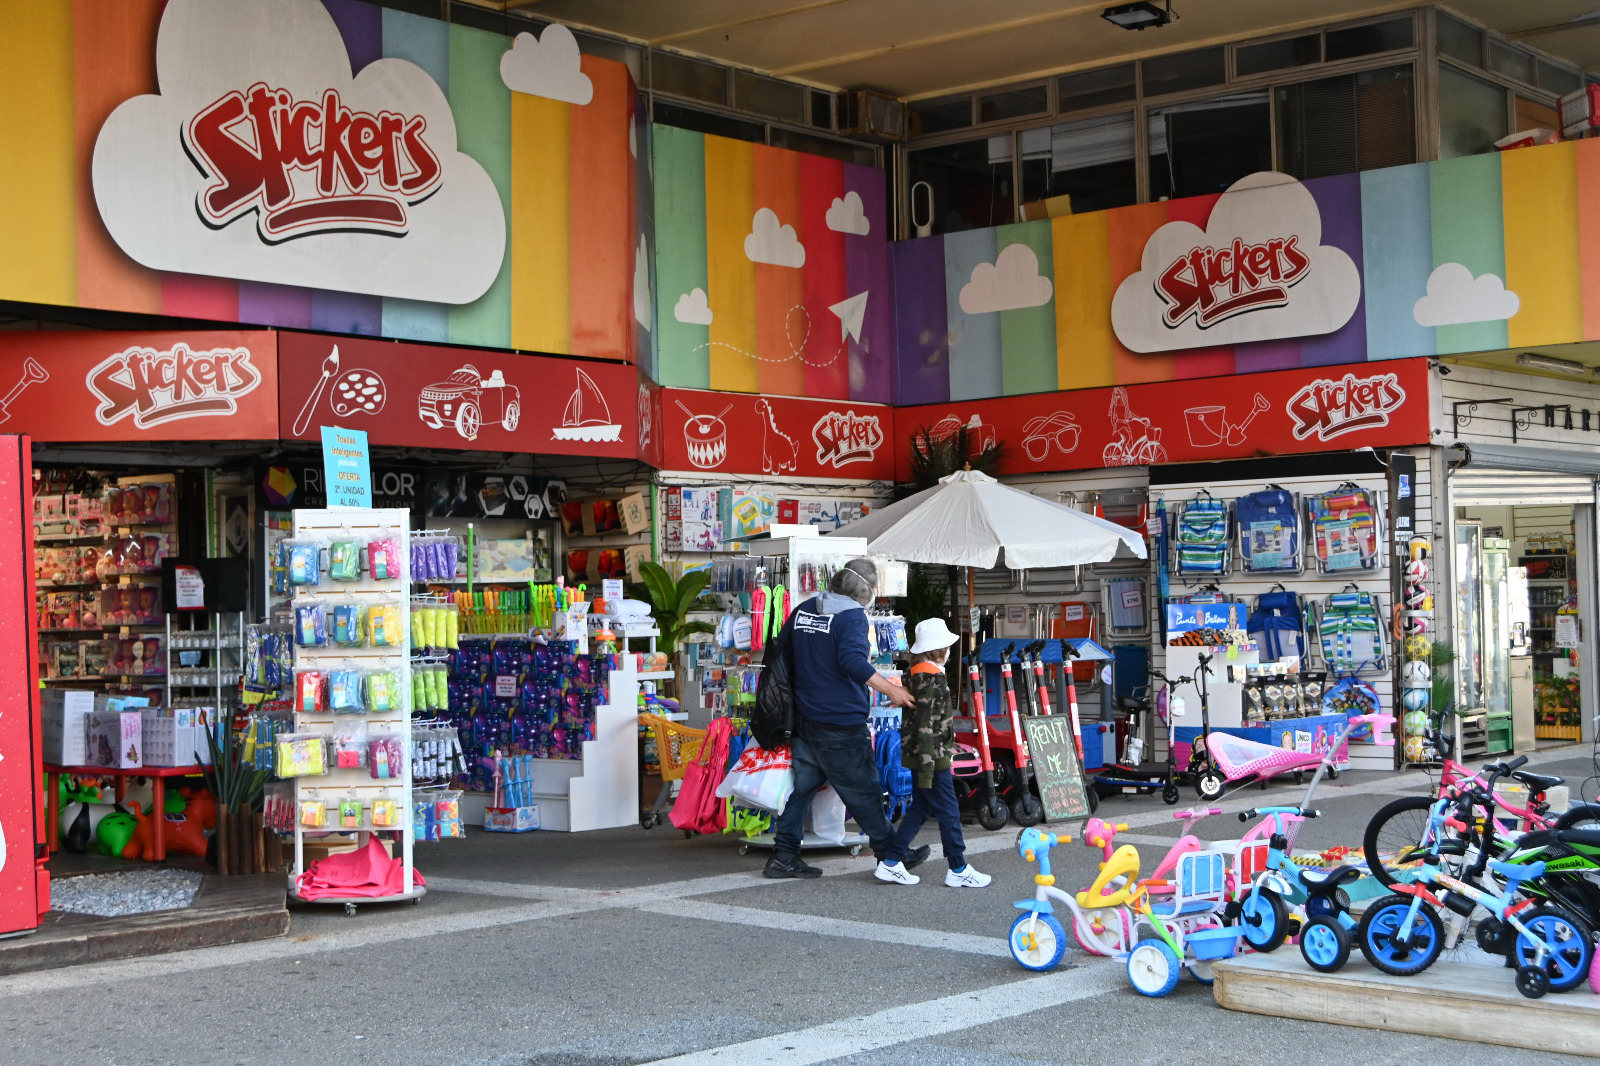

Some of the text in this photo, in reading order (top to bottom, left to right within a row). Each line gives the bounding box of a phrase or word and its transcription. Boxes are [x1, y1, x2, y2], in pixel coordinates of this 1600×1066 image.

[181, 82, 443, 236] Stickers
[1154, 235, 1311, 328] Stickers
[86, 342, 262, 428] Stickers
[1286, 373, 1406, 442] Stickers
[812, 410, 884, 468] Stickers
[338, 471, 361, 481] OFERTA
[343, 486, 365, 495] UNIDAD
[340, 498, 348, 506] AL
[1029, 722, 1065, 751] RENT
[1046, 752, 1065, 776] ME
[1544, 859, 1585, 871] awasaki
